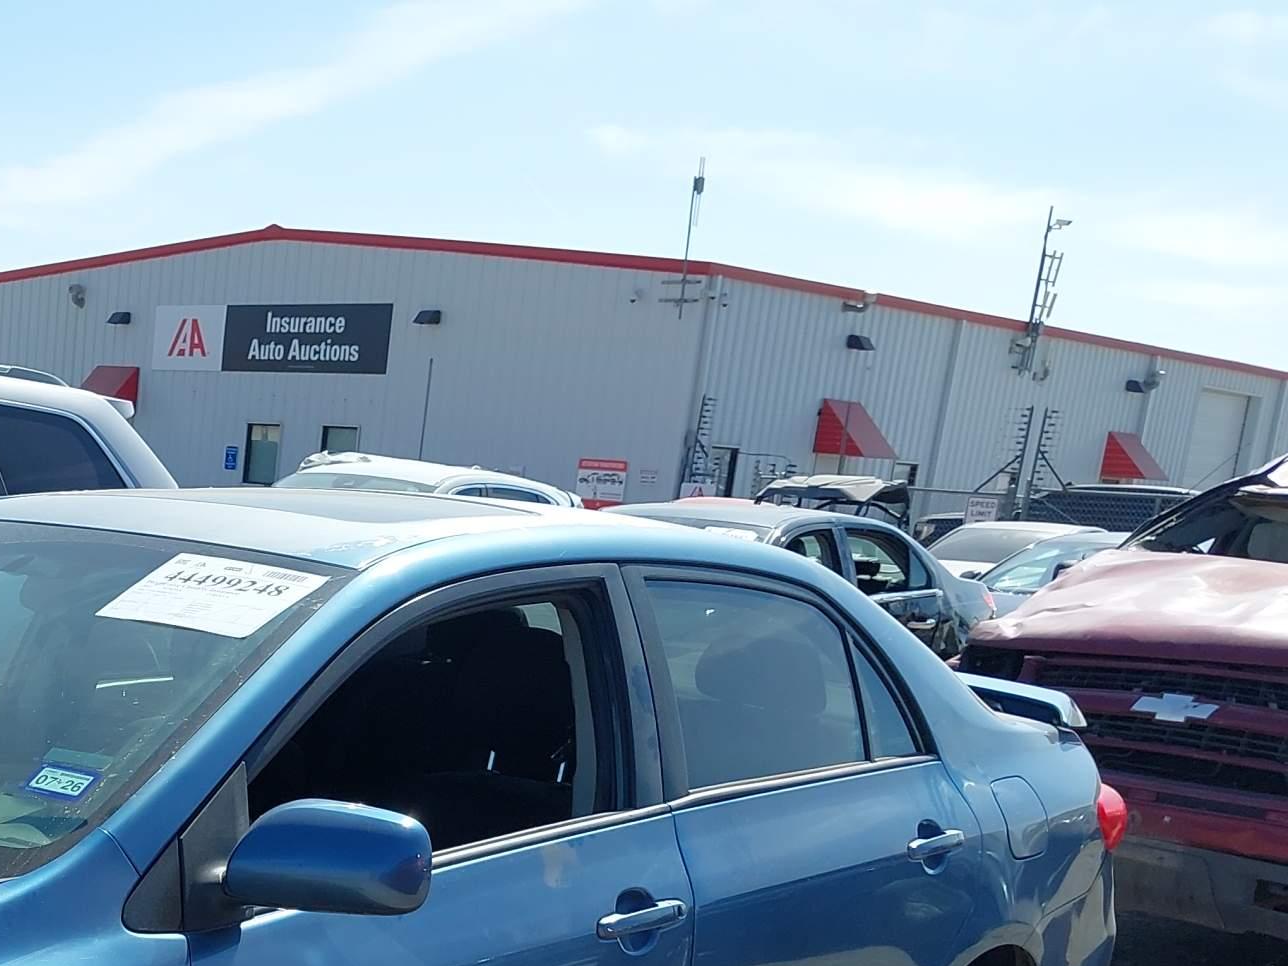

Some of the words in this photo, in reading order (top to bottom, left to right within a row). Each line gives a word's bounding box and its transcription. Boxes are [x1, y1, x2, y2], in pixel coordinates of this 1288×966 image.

[266, 311, 346, 334] Insurance
[248, 338, 284, 361] Auto
[287, 338, 359, 362] Auctions
[968, 500, 996, 509] SPEED
[970, 509, 993, 517] LIMIT
[164, 570, 290, 598] 44499248
